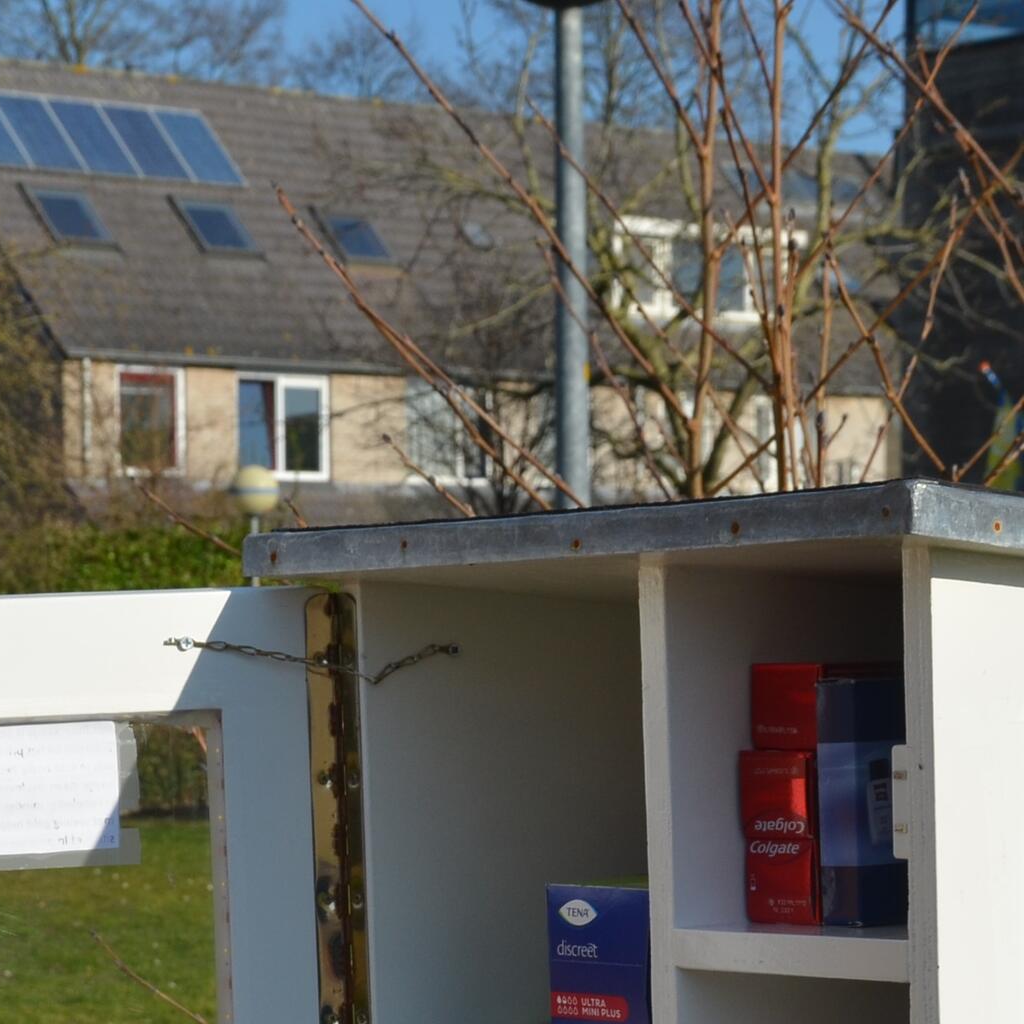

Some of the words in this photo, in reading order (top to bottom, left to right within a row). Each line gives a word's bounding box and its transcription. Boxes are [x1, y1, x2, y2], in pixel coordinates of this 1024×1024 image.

[754, 817, 805, 834] Colgate
[750, 840, 800, 857] Colgate
[566, 906, 589, 919] TENA
[557, 939, 598, 959] discreet
[581, 998, 606, 1008] ULTRA
[581, 1008, 600, 1017] MINI
[601, 1009, 621, 1019] PLUS
